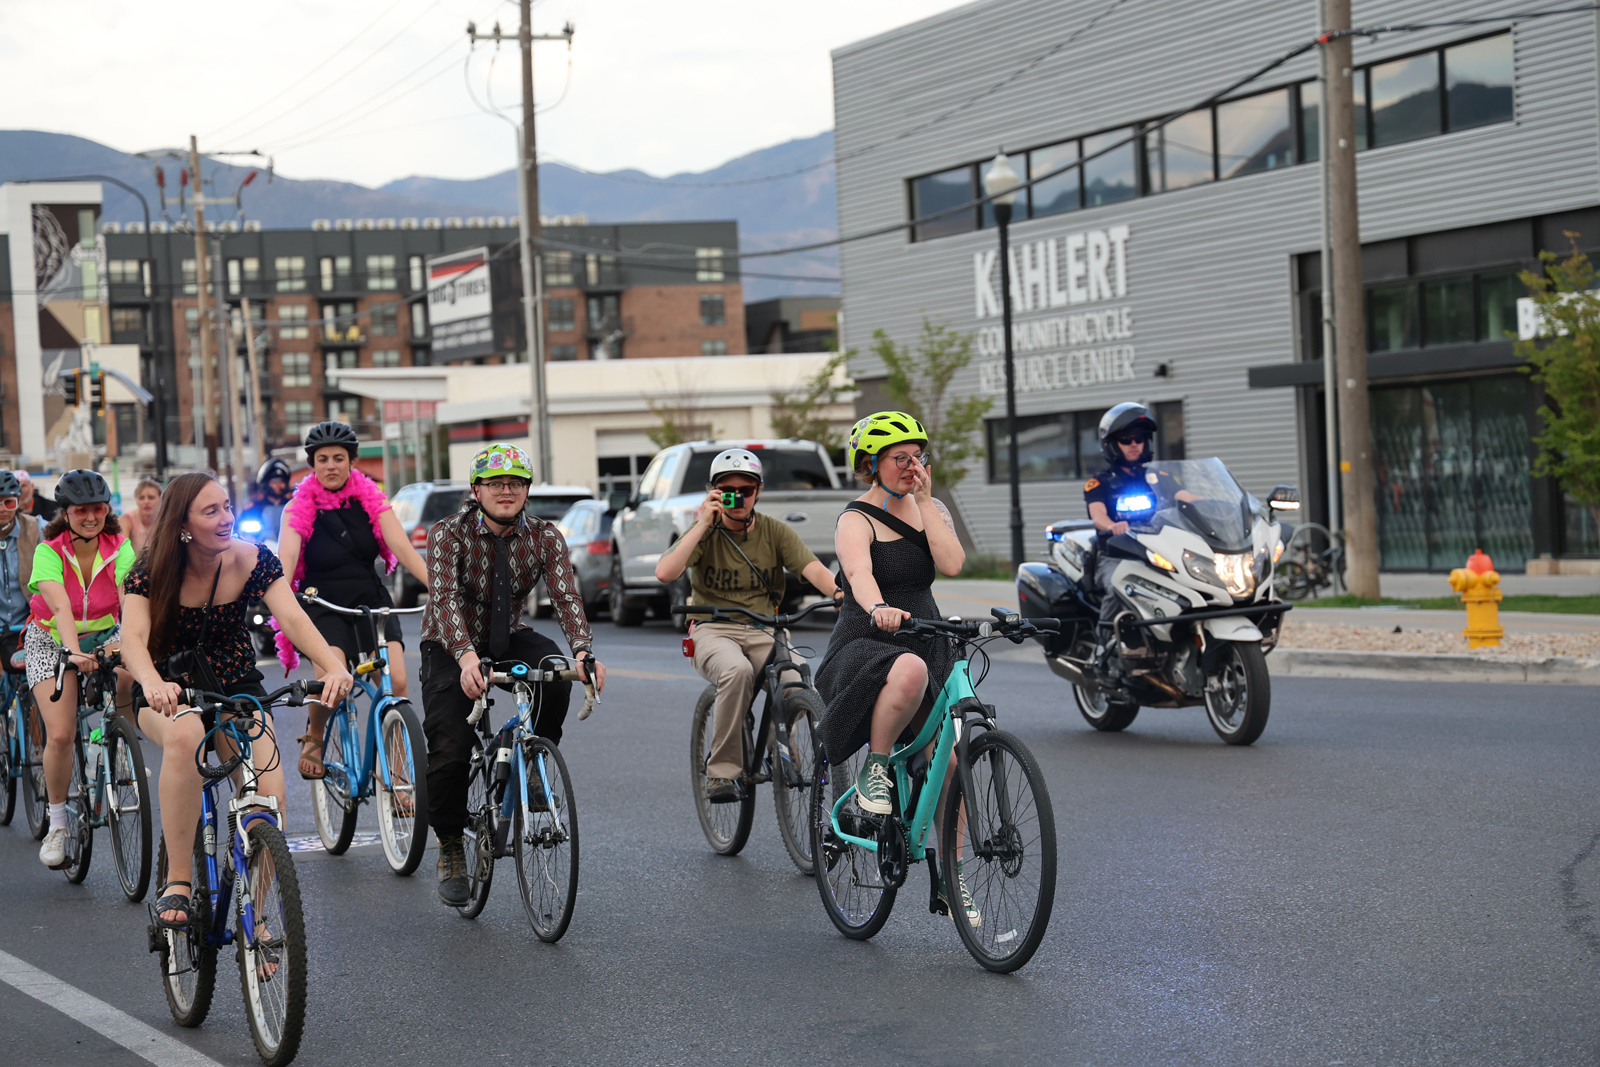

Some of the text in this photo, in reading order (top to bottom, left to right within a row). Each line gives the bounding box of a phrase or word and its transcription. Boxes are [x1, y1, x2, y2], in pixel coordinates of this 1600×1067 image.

[974, 225, 1130, 318] KAHLERT
[1069, 306, 1133, 344] BICYCLE
[1067, 344, 1135, 387] CENTER
[704, 565, 743, 591] GIRL
